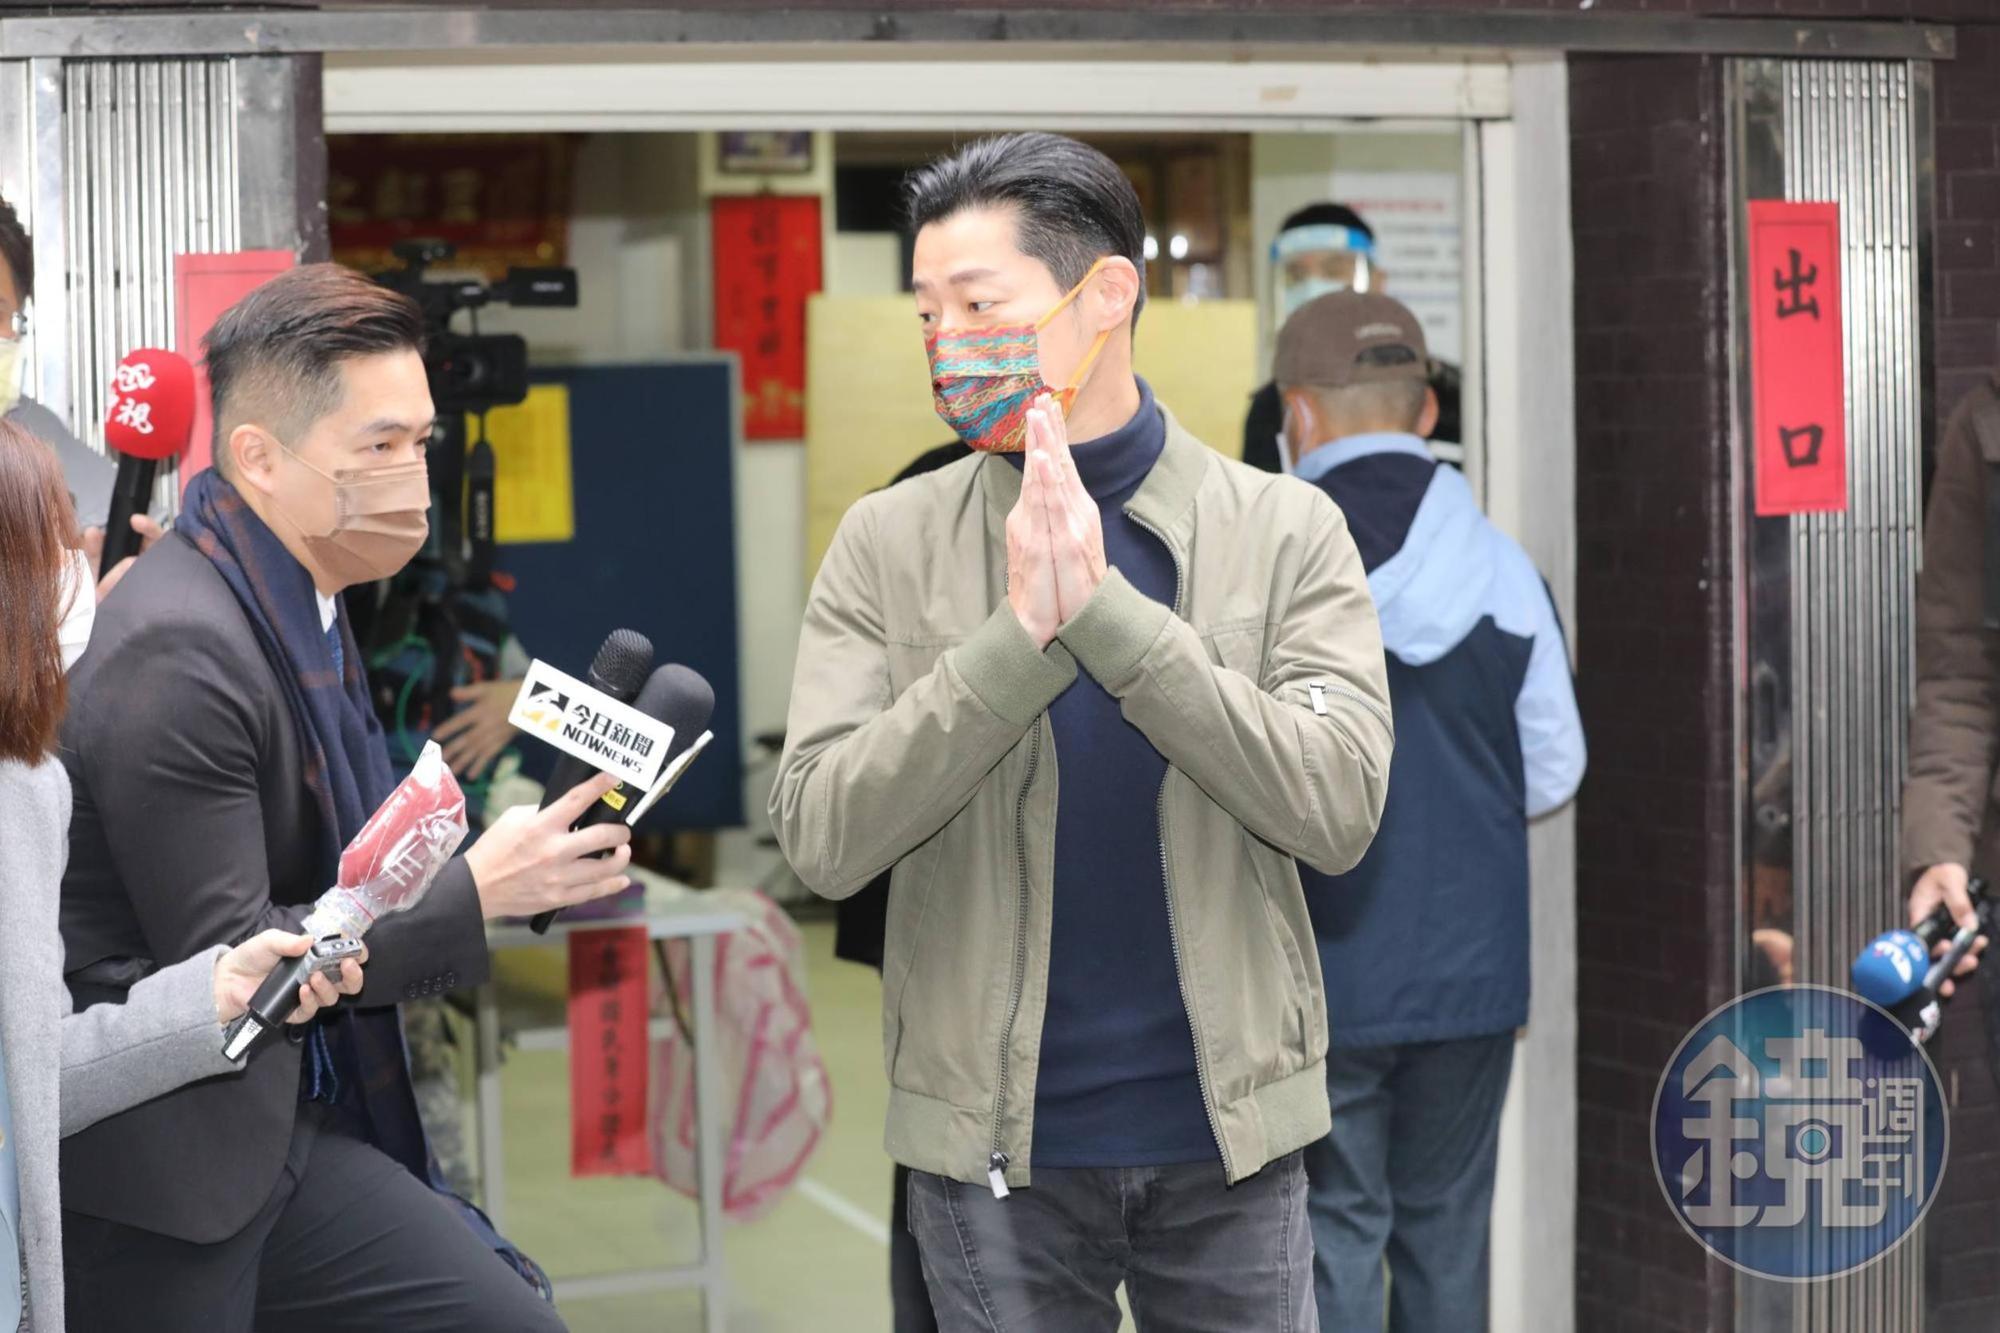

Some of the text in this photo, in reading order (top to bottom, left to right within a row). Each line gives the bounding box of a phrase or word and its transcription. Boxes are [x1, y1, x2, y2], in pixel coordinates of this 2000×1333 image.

[1773, 246, 1824, 468] 出口
[562, 722, 645, 774] NOWNEWS
[572, 703, 656, 758] 今日新聞
